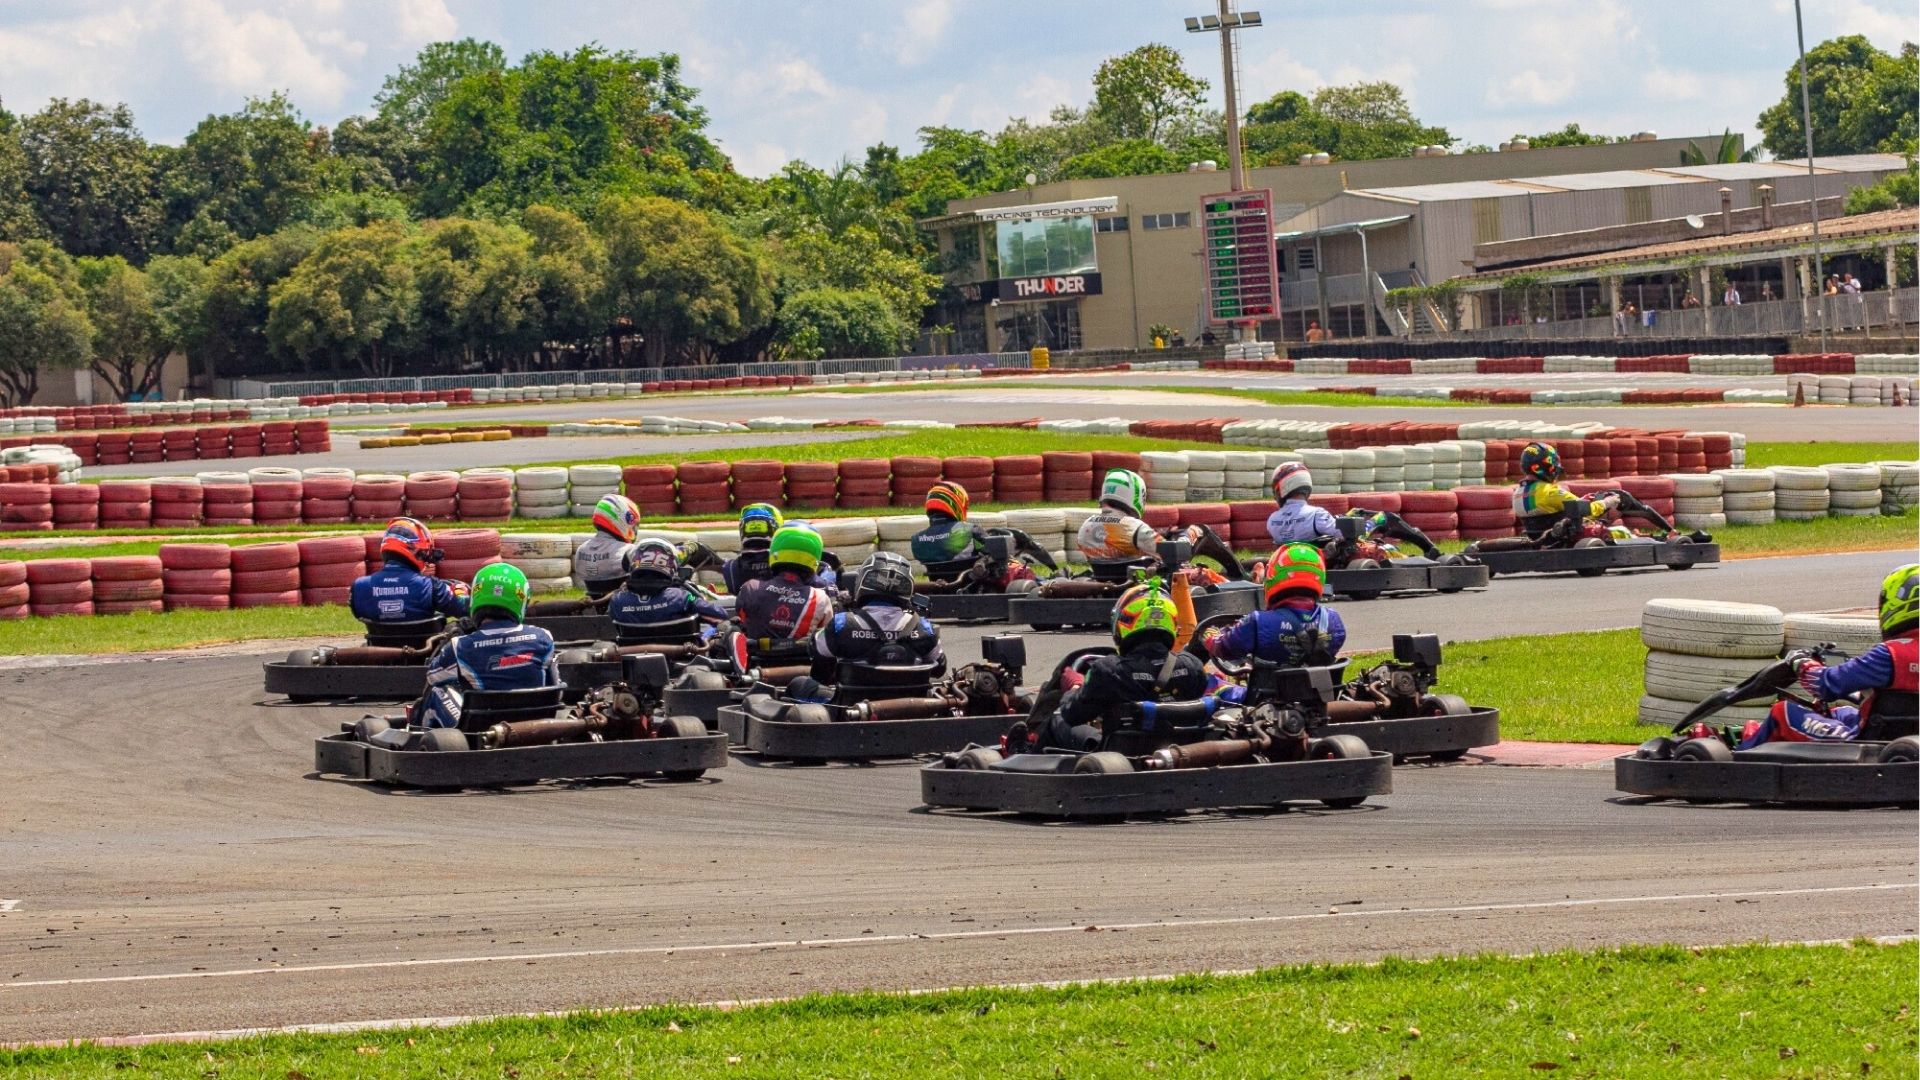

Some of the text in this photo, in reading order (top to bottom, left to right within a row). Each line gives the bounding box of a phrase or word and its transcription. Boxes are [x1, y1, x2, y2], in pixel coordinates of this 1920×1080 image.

[986, 205, 1113, 220] RACING TECHNOLOGY
[1014, 276, 1085, 296] THUNDER
[641, 551, 669, 567] 26
[766, 585, 801, 597] Rodrigo
[778, 596, 806, 604] Prado
[852, 630, 893, 640] ROBEO
